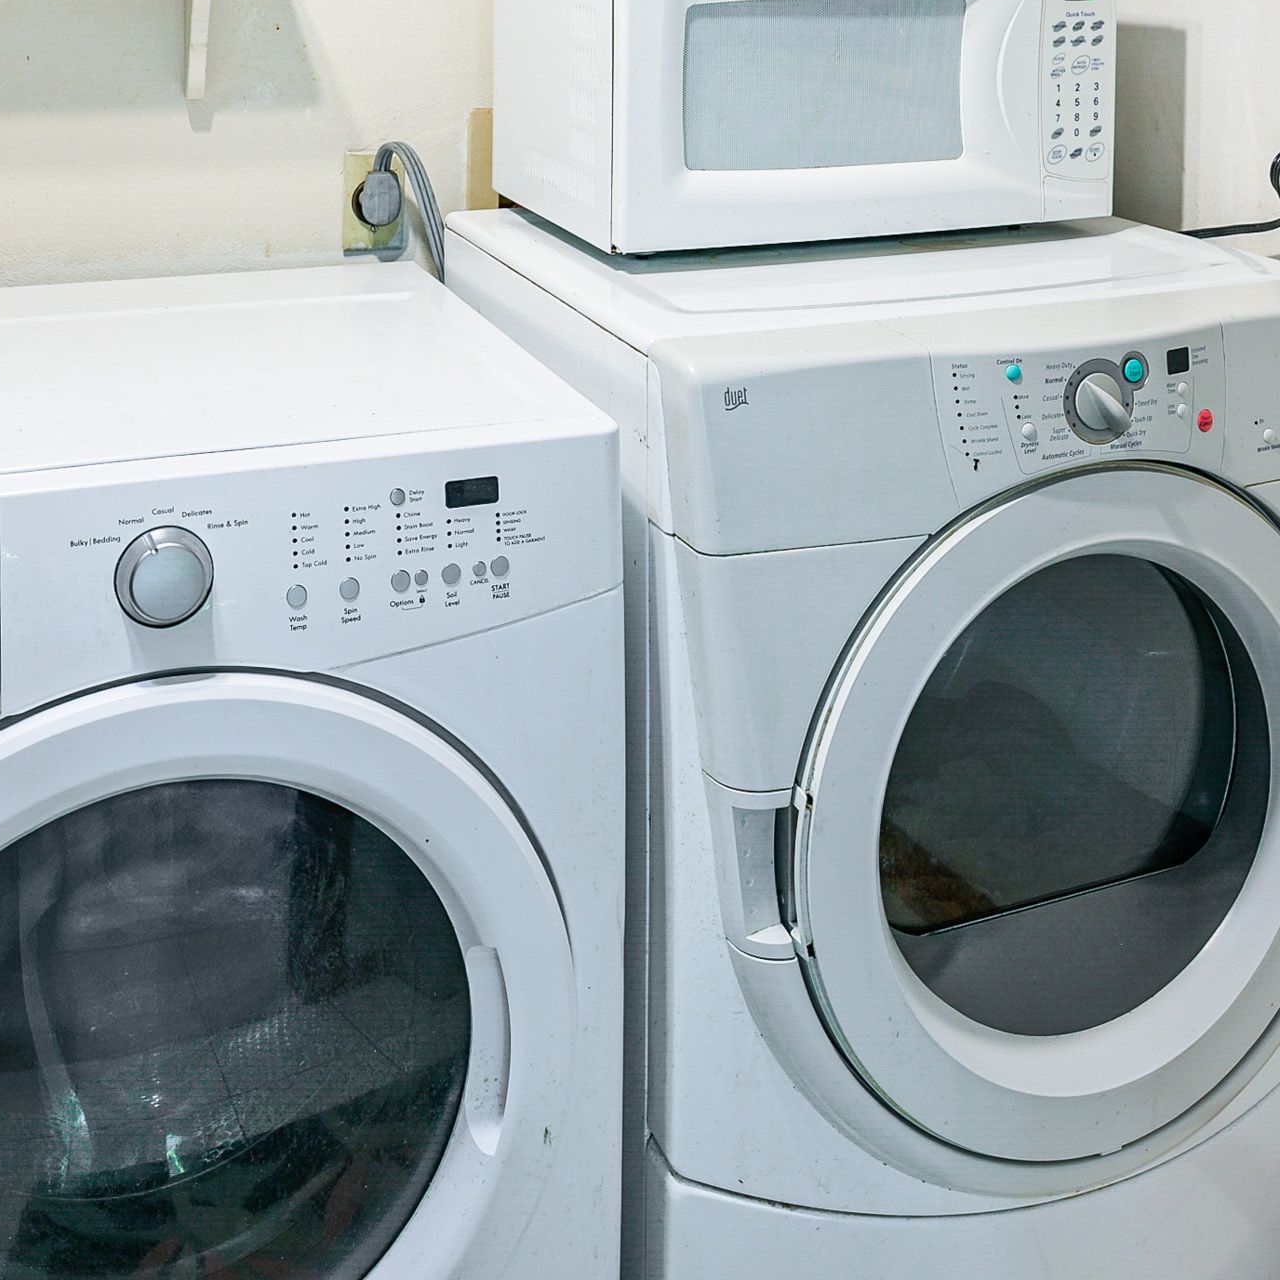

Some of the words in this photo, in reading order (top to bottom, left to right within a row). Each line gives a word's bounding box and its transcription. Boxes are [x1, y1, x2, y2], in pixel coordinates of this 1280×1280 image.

[1074, 82, 1081, 92] 2
[1093, 81, 1100, 92] 3
[1074, 97, 1081, 107] 5
[1093, 96, 1100, 106] 6
[1074, 112, 1080, 122] 8
[996, 358, 1015, 366] Control
[1044, 377, 1064, 385] Normal
[723, 386, 749, 408] duet
[1042, 393, 1060, 402] Casual
[1041, 412, 1062, 421] Delicate
[1052, 427, 1066, 435] Super
[1125, 430, 1139, 439] Quick
[1138, 429, 1147, 438] Dry
[1049, 433, 1069, 442] Delicate
[1020, 441, 1040, 449] Dryness
[1109, 442, 1128, 450] Manual
[1127, 439, 1142, 448] Cycles
[1041, 452, 1069, 461] Automatic
[1069, 448, 1085, 458] Cycles
[408, 489, 425, 497] Delay
[151, 506, 175, 516] Casual
[181, 508, 213, 518] Delicates
[118, 516, 145, 526] Normal
[233, 519, 249, 528] Spin
[352, 517, 366, 525] High
[453, 517, 471, 525] Heavy
[353, 529, 376, 537] Medium
[454, 528, 475, 536] Normal
[69, 539, 89, 548] Bulky
[92, 535, 121, 545] Bedding
[300, 536, 315, 544] Cool
[455, 541, 469, 549] Light
[470, 578, 490, 586] CANCEL
[490, 582, 511, 592] START
[446, 591, 458, 599] Soil
[492, 591, 511, 600] PAUSE
[389, 598, 415, 609] Options
[444, 599, 461, 608] Level
[343, 608, 358, 616] Spin
[288, 614, 308, 623] Wash
[340, 614, 362, 625] Speed
[289, 624, 308, 632] Temp
